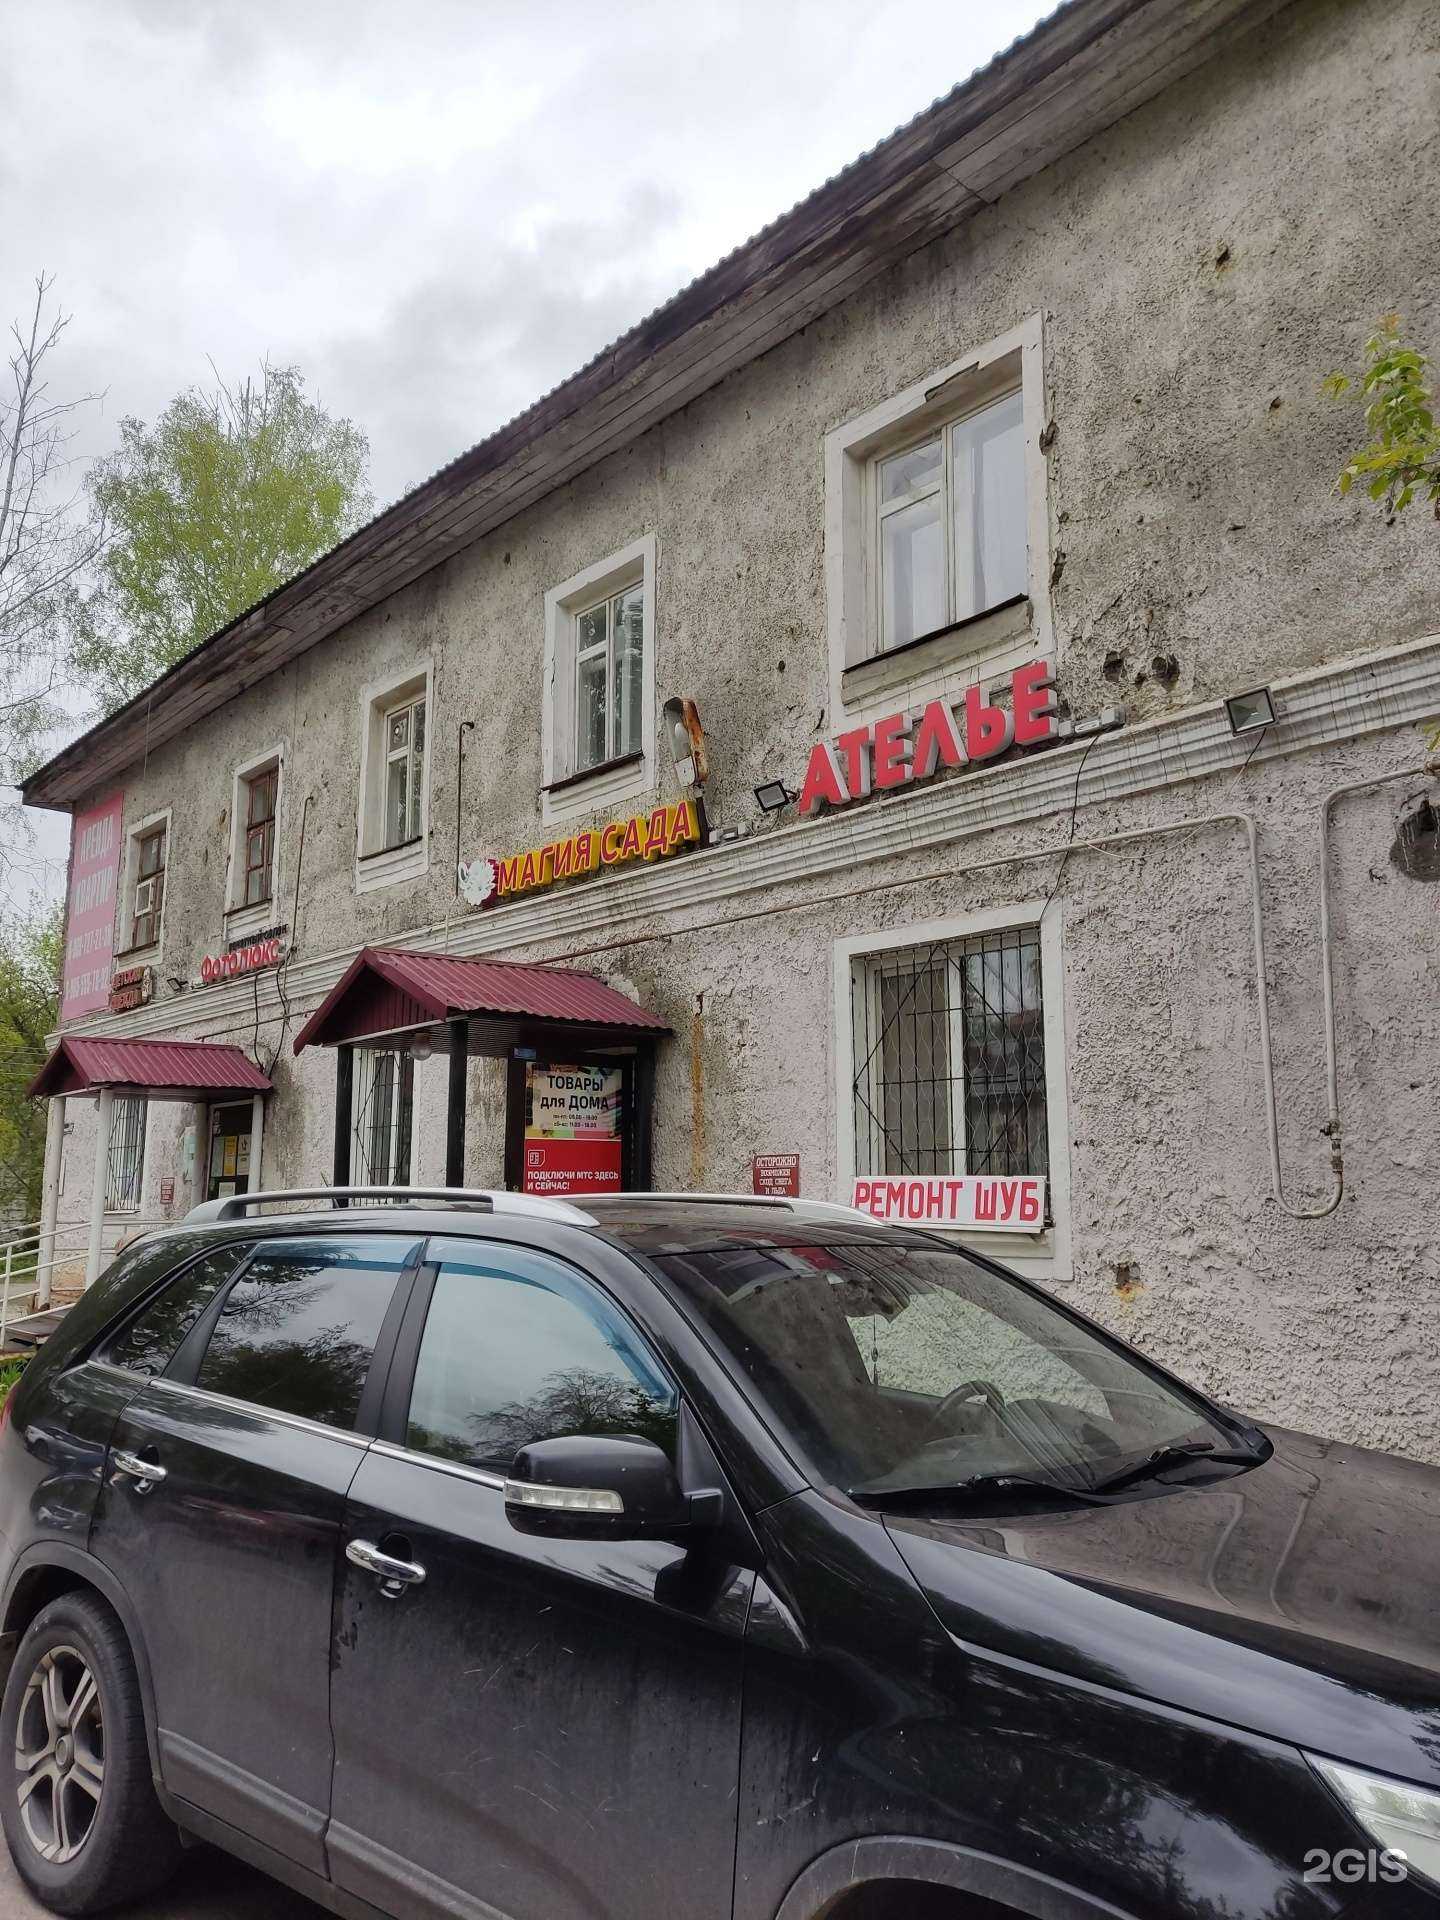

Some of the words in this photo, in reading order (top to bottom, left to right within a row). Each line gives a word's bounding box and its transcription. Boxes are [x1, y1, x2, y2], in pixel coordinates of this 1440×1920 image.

[799, 660, 1054, 815] АТЕЛЬЕ
[498, 833, 593, 896] МАГИЯ
[601, 800, 696, 865] САДА
[547, 1075, 603, 1092] ТОВАРЫ
[541, 1096, 565, 1109] для
[569, 1095, 609, 1111] ДОМА
[756, 1156, 797, 1167] ОСТОРОЖНО
[527, 1171, 575, 1181] ПОДКЛЮЧИ
[577, 1171, 593, 1179] МТС
[595, 1171, 619, 1180] ЗДЕСЬ
[535, 1179, 570, 1190] СЕЙЧАС!
[855, 1181, 964, 1220] РЕМОНТ
[975, 1181, 1040, 1222] ШУБ
